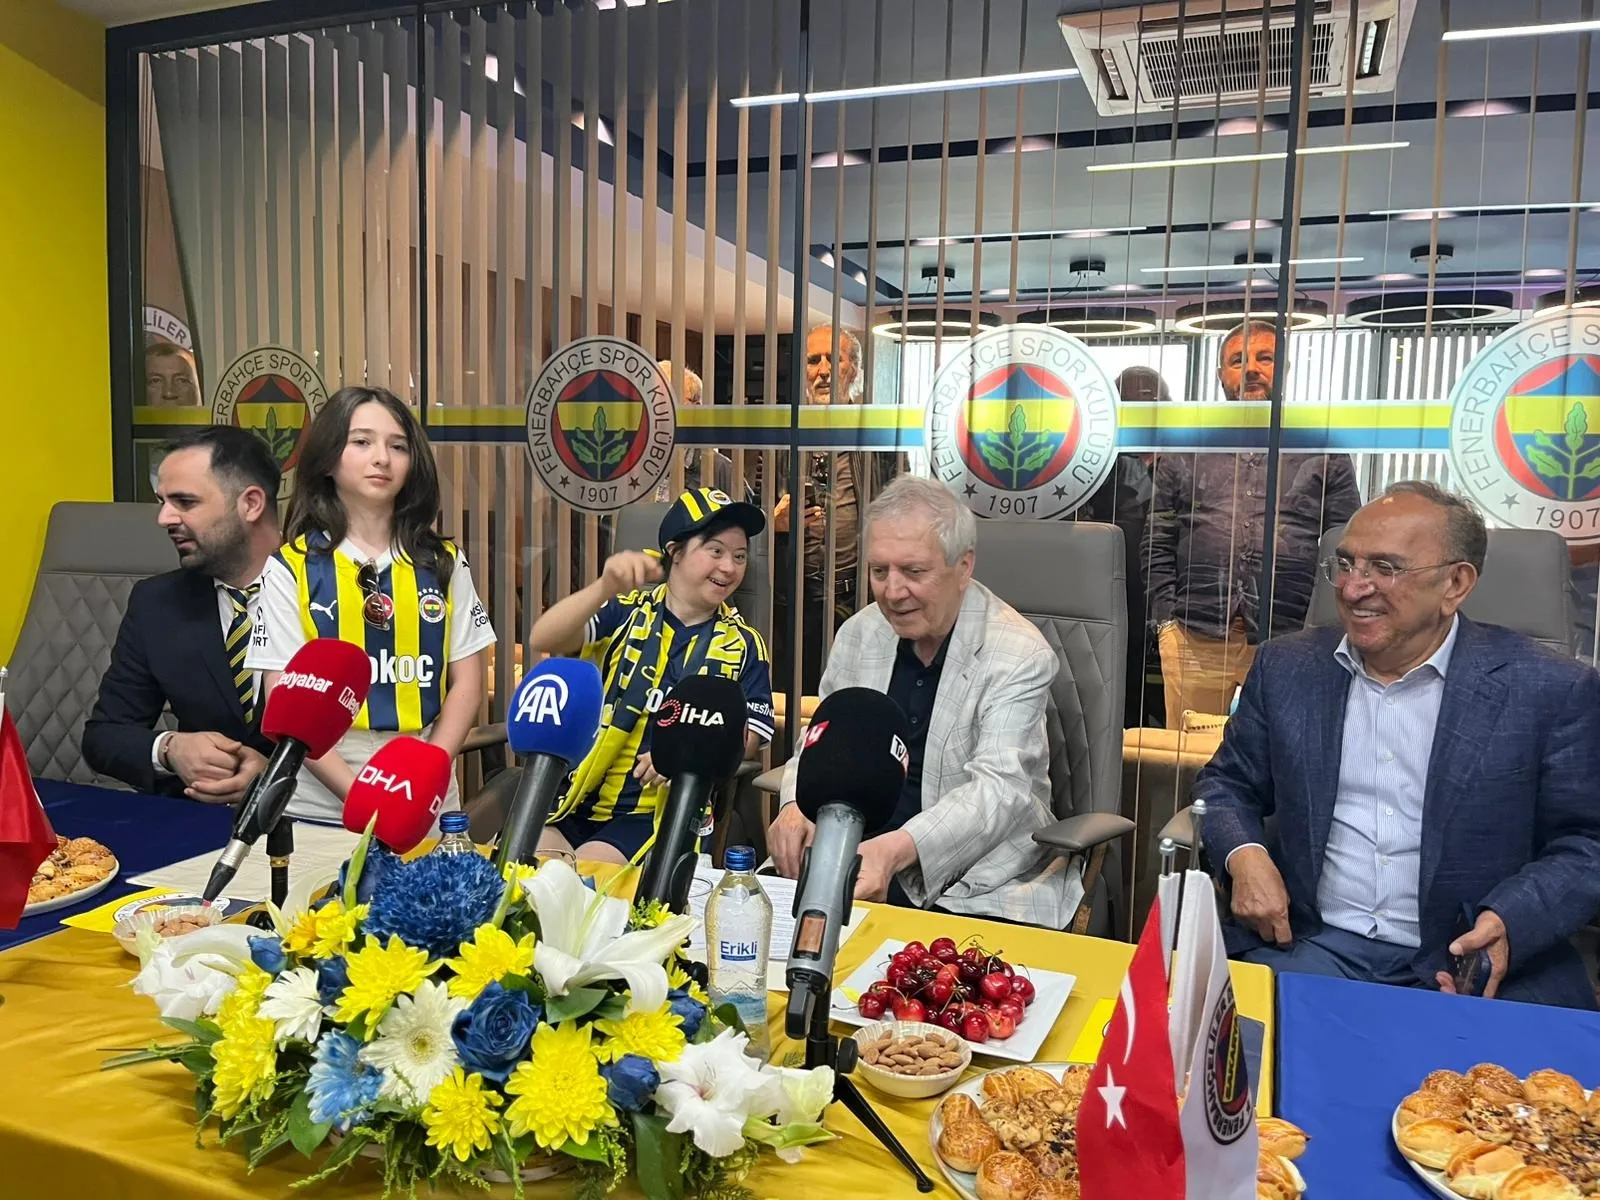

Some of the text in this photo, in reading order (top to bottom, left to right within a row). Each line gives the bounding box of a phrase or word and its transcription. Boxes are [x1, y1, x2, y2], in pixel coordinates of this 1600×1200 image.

[216, 354, 265, 426] ERBAHÇE
[269, 354, 312, 389] SPOR
[532, 348, 593, 474] FENERBAHÇE
[599, 347, 652, 386] SPOR
[643, 385, 672, 477] KULÜBÜ
[932, 337, 1111, 485] FENERBAHÇE SPOR KULÜBÜ
[1460, 325, 1571, 491] FENERBAHÇE
[578, 486, 618, 503] 1907
[989, 495, 1038, 515] 1907
[1536, 506, 1600, 530] 1907
[278, 671, 334, 693] edyabar
[514, 686, 562, 726] AA
[680, 703, 724, 726] İHA
[358, 765, 413, 801] DHA
[720, 940, 758, 955] Erikli
